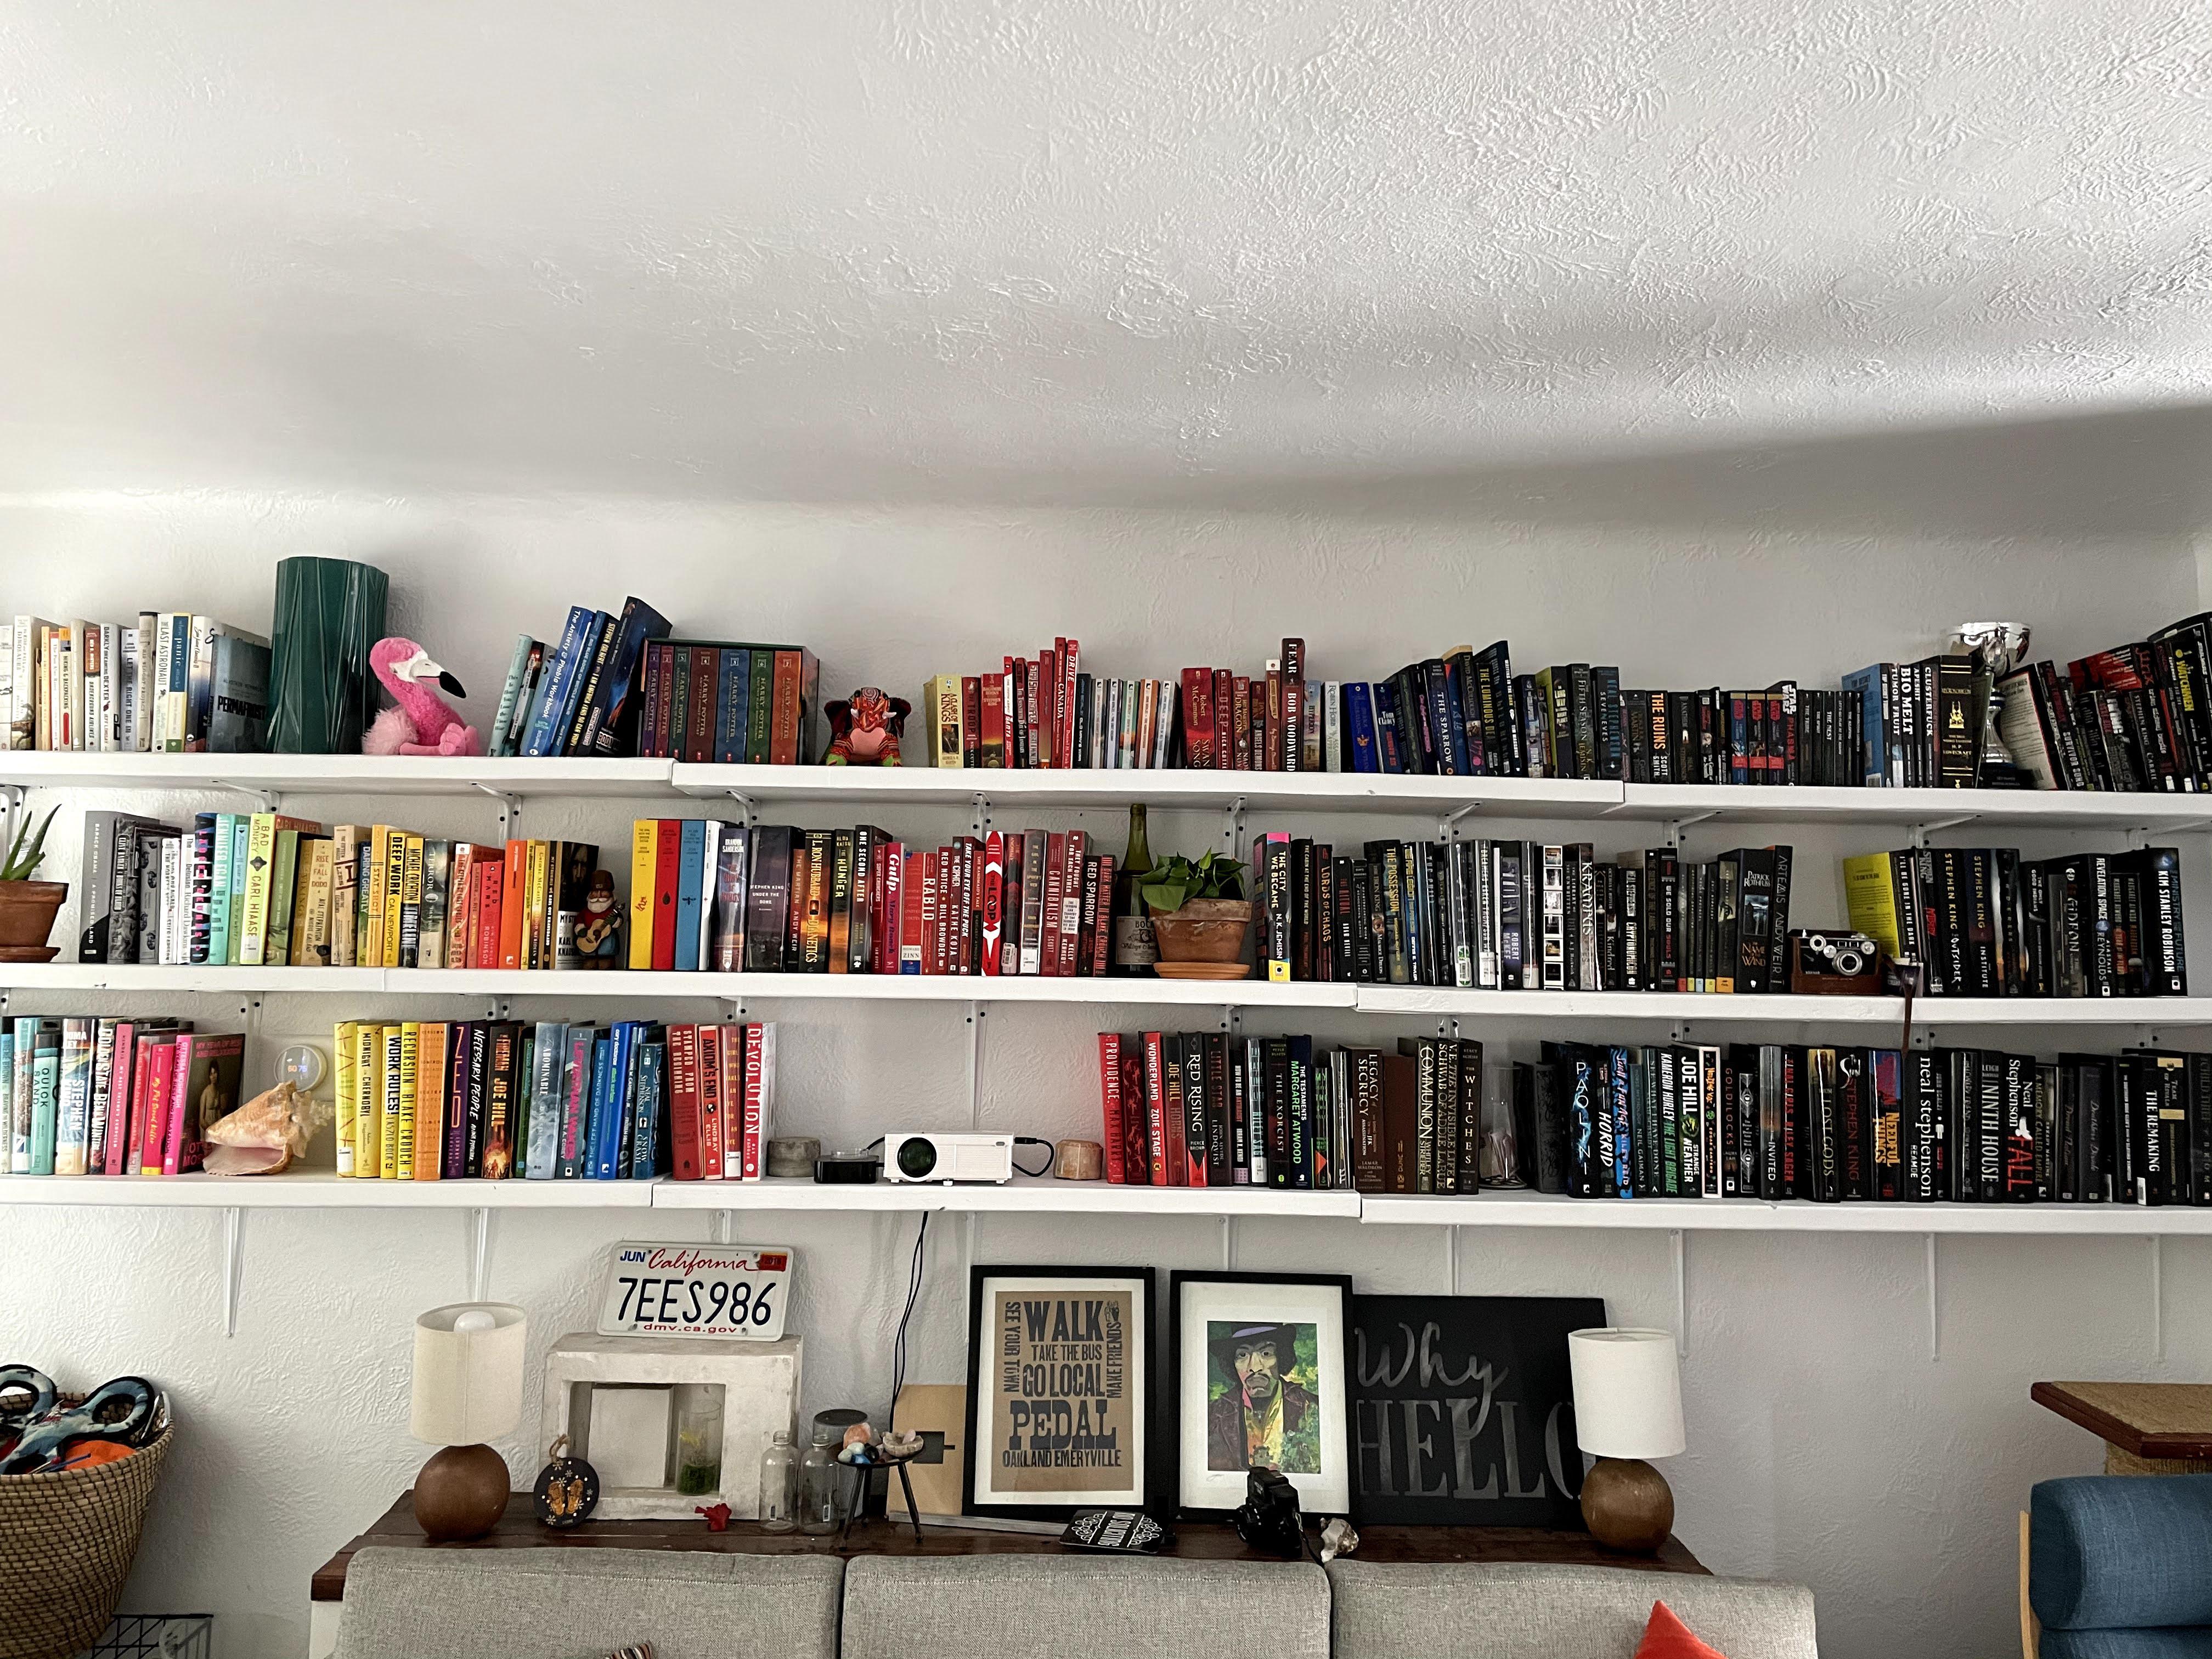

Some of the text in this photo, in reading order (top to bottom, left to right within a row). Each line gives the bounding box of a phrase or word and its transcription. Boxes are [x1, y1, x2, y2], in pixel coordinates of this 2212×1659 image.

[562, 624, 577, 651] Anxiety
[572, 611, 580, 623] The
[158, 627, 169, 685] LAST ASTRONAUT
[554, 659, 565, 682] Phobia
[1067, 656, 1076, 682] DRIVE
[1288, 644, 1297, 673] FEAR
[543, 685, 559, 718] Workbook
[941, 693, 951, 723] KINGS
[1900, 668, 1913, 735] BIO MELT
[1924, 667, 1933, 737] CLUSTERFUCK
[2176, 661, 2194, 711] WATCHMEN
[1286, 693, 1296, 771] BOB WOODWARD
[1437, 692, 1452, 763] THE SPARROW
[1651, 693, 1666, 749] THE RUINS
[1192, 740, 1201, 768] SONG
[1202, 739, 1211, 767] SWAN
[215, 817, 229, 887] JENNIFER EGAN
[251, 819, 259, 853] MONKEY
[261, 826, 270, 846] BAD
[811, 848, 822, 862] RON
[360, 847, 371, 913] DARING GREATLY
[390, 837, 403, 895] DEEP WORK
[809, 863, 821, 896] HUBBARD
[856, 831, 867, 902] ONE SECOND AFTER
[886, 854, 900, 894] Gulp.
[940, 868, 948, 894] NOTICE
[1271, 856, 1278, 870] WE
[1321, 866, 1330, 899] LORDS
[1776, 855, 1787, 903] ARTEMIS
[247, 876, 261, 936] CARL HIAASE
[923, 878, 935, 921] RABID
[1046, 871, 1060, 928] CANNIBALISM
[1582, 862, 1593, 935] KRAMPUS
[1945, 853, 1957, 929] STEPHEN KING
[805, 919, 819, 962] DIANETICS
[938, 922, 947, 957] BROWDER
[1323, 911, 1331, 941] CHAOS
[1773, 912, 1785, 973] ANDY WEIR
[2158, 871, 2175, 972] KIM STANLEY ROBINSON
[1951, 938, 1961, 984] OUTSIDER
[362, 1033, 371, 1067] MIDNIGHT
[402, 1031, 416, 1084] RECURSION
[470, 1029, 485, 1120] NECESSARY PEOPLE
[1148, 1043, 1159, 1101] WONDERLAND
[360, 1077, 371, 1116] CHERNOBYL
[387, 1037, 400, 1115] WORK RULES!
[746, 1028, 761, 1135] DEVOLUTION
[1187, 1054, 1201, 1132] RED RISING
[1419, 1045, 1434, 1139] COMMUNION
[1661, 1053, 1675, 1121] KAMERON HURLEY
[1681, 1057, 1697, 1115] JOE HILL
[2006, 1059, 2020, 1126] Stephenson
[2023, 1081, 2033, 1107] Neal
[399, 1094, 414, 1165] BLAKE CROUCH
[1150, 1109, 1161, 1157] ZOIE STAGE
[1291, 1061, 1301, 1164] MARGARET ATWOOD
[1915, 1057, 1934, 1197] neal stephenson
[1981, 1085, 1999, 1182] NINTH HOUSE
[2146, 1090, 2160, 1171] THE REMAKING
[1599, 1111, 1613, 1167] HORRID
[1683, 1138, 1693, 1182] WEATHER
[1872, 1116, 1887, 1164] THINGS
[1886, 1112, 1900, 1167] NEEDFUL
[2007, 1136, 2033, 1192] FALL
[620, 1250, 646, 1263] JUN
[648, 1248, 759, 1277] California
[618, 1277, 776, 1326] 7EES986
[1024, 1300, 1104, 1342] WALK
[643, 1323, 737, 1334] dmv.ca.gov
[1003, 1301, 1021, 1393] SEE YOUR TOWN
[1031, 1344, 1103, 1362] TAKE THE BUS
[1022, 1363, 1105, 1397] GO LOCAL
[1107, 1321, 1122, 1399] MAKE FRIENDS
[1354, 1321, 1510, 1440] Why
[1009, 1399, 1116, 1450] PEDAL
[1002, 1449, 1122, 1468] OAKLAND EMERYVILLE
[1112, 1511, 1136, 1520] NO
